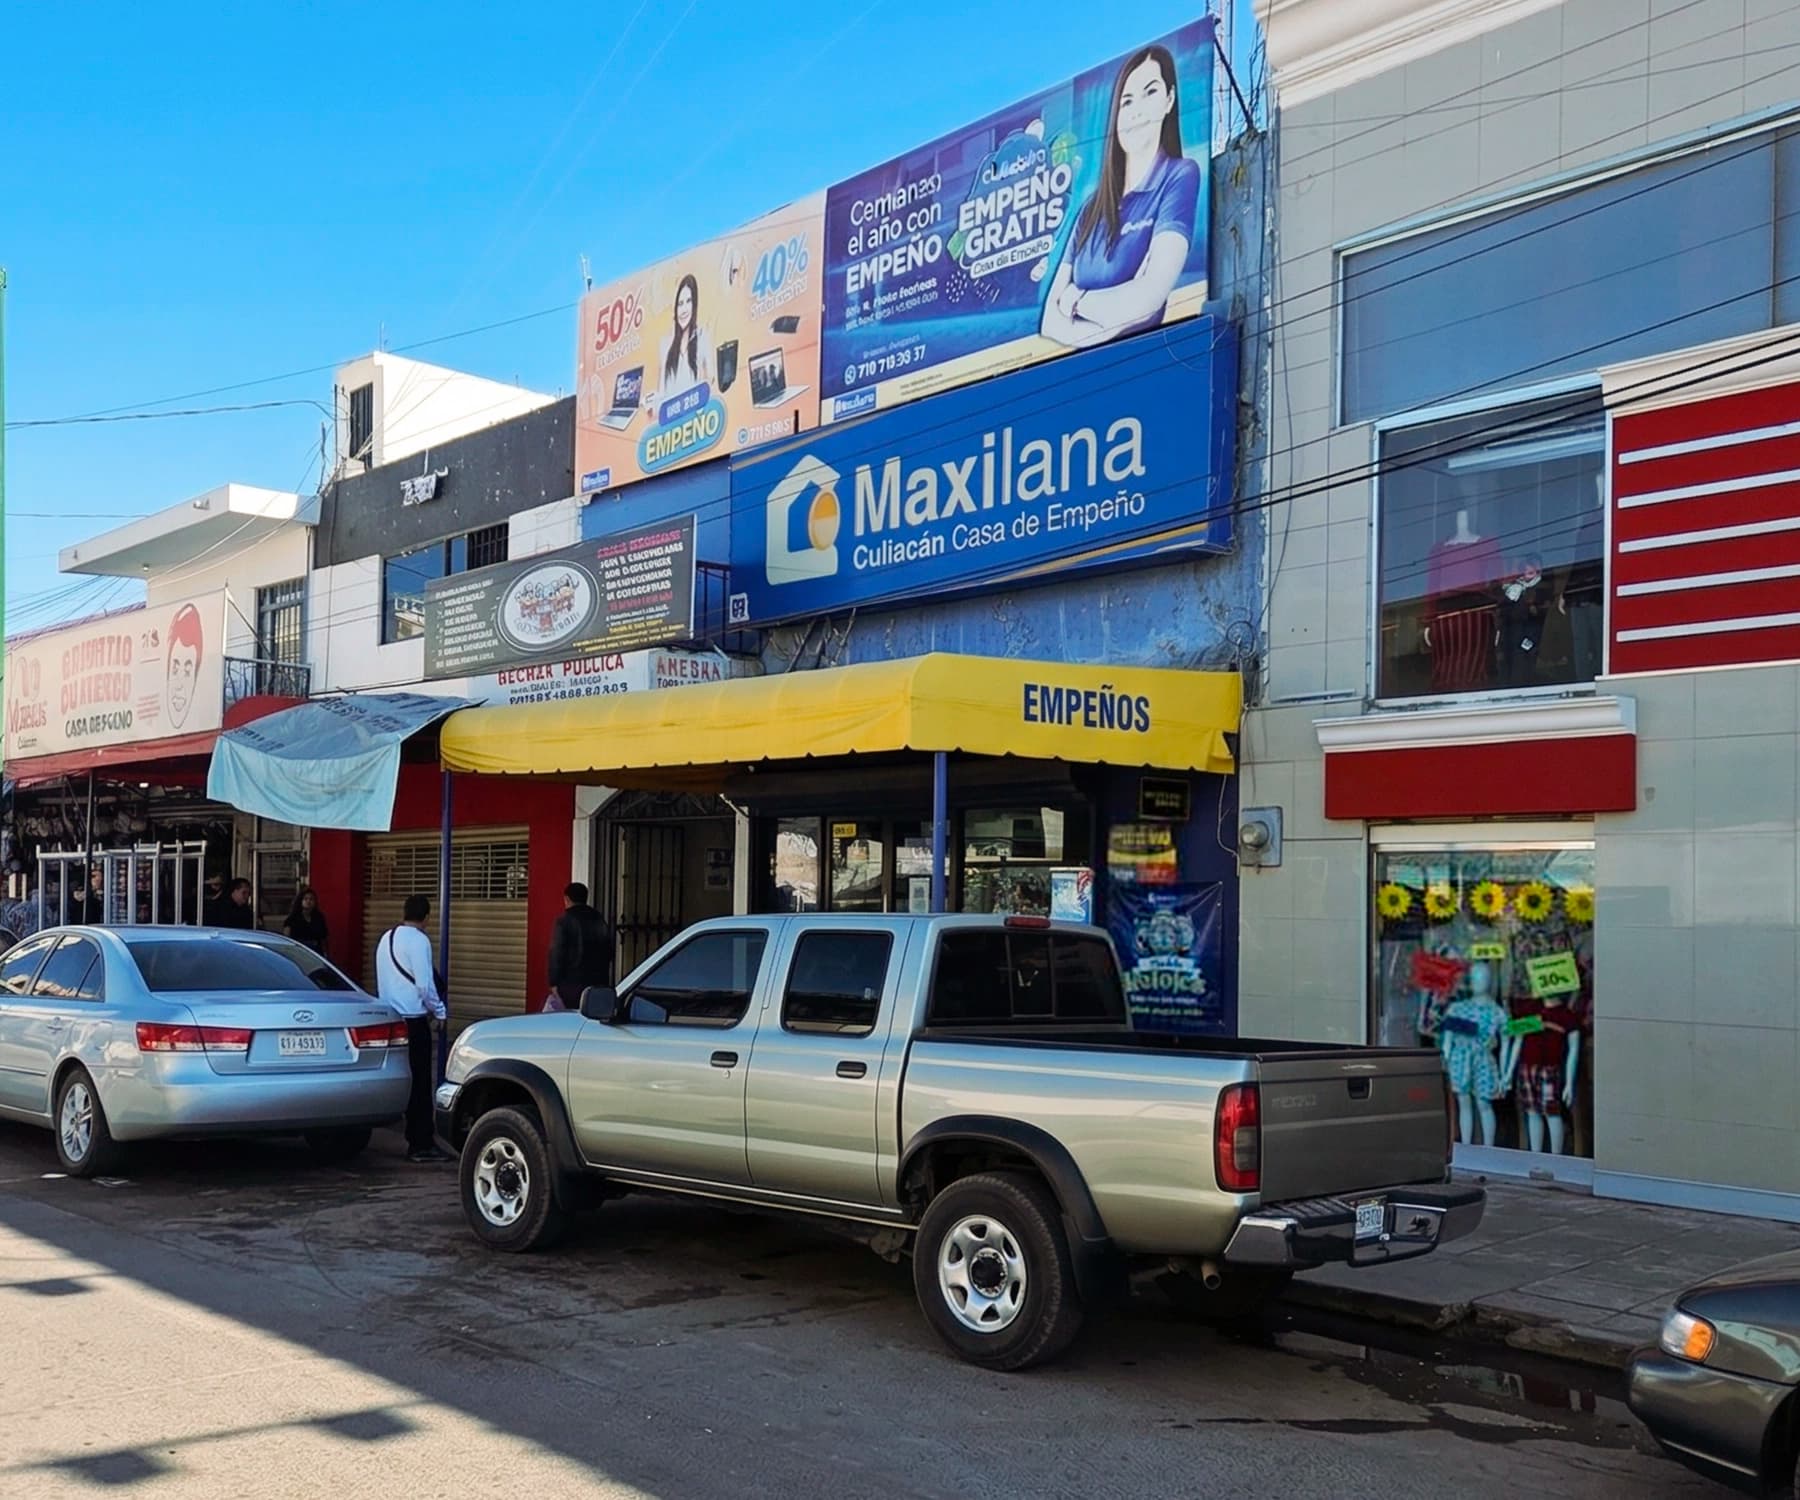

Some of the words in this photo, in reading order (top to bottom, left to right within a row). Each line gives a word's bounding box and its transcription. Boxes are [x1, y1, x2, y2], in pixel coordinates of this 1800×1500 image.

[848, 226, 863, 256] el
[867, 216, 903, 248] año
[907, 202, 942, 232] con
[958, 163, 1073, 232] EMPEÑO
[964, 197, 1065, 258] GRATIS
[752, 233, 809, 299] 40%
[846, 233, 943, 295] EMPEÑO
[595, 287, 643, 352] 50%
[645, 408, 720, 466] EMPEÑO
[852, 416, 1147, 537] Maxilana
[853, 534, 945, 570] Culiacán
[952, 519, 1006, 551] Casa
[1011, 509, 1040, 538] de
[1047, 490, 1146, 532] Empeño
[1024, 684, 1150, 733] EMPEÑOS
